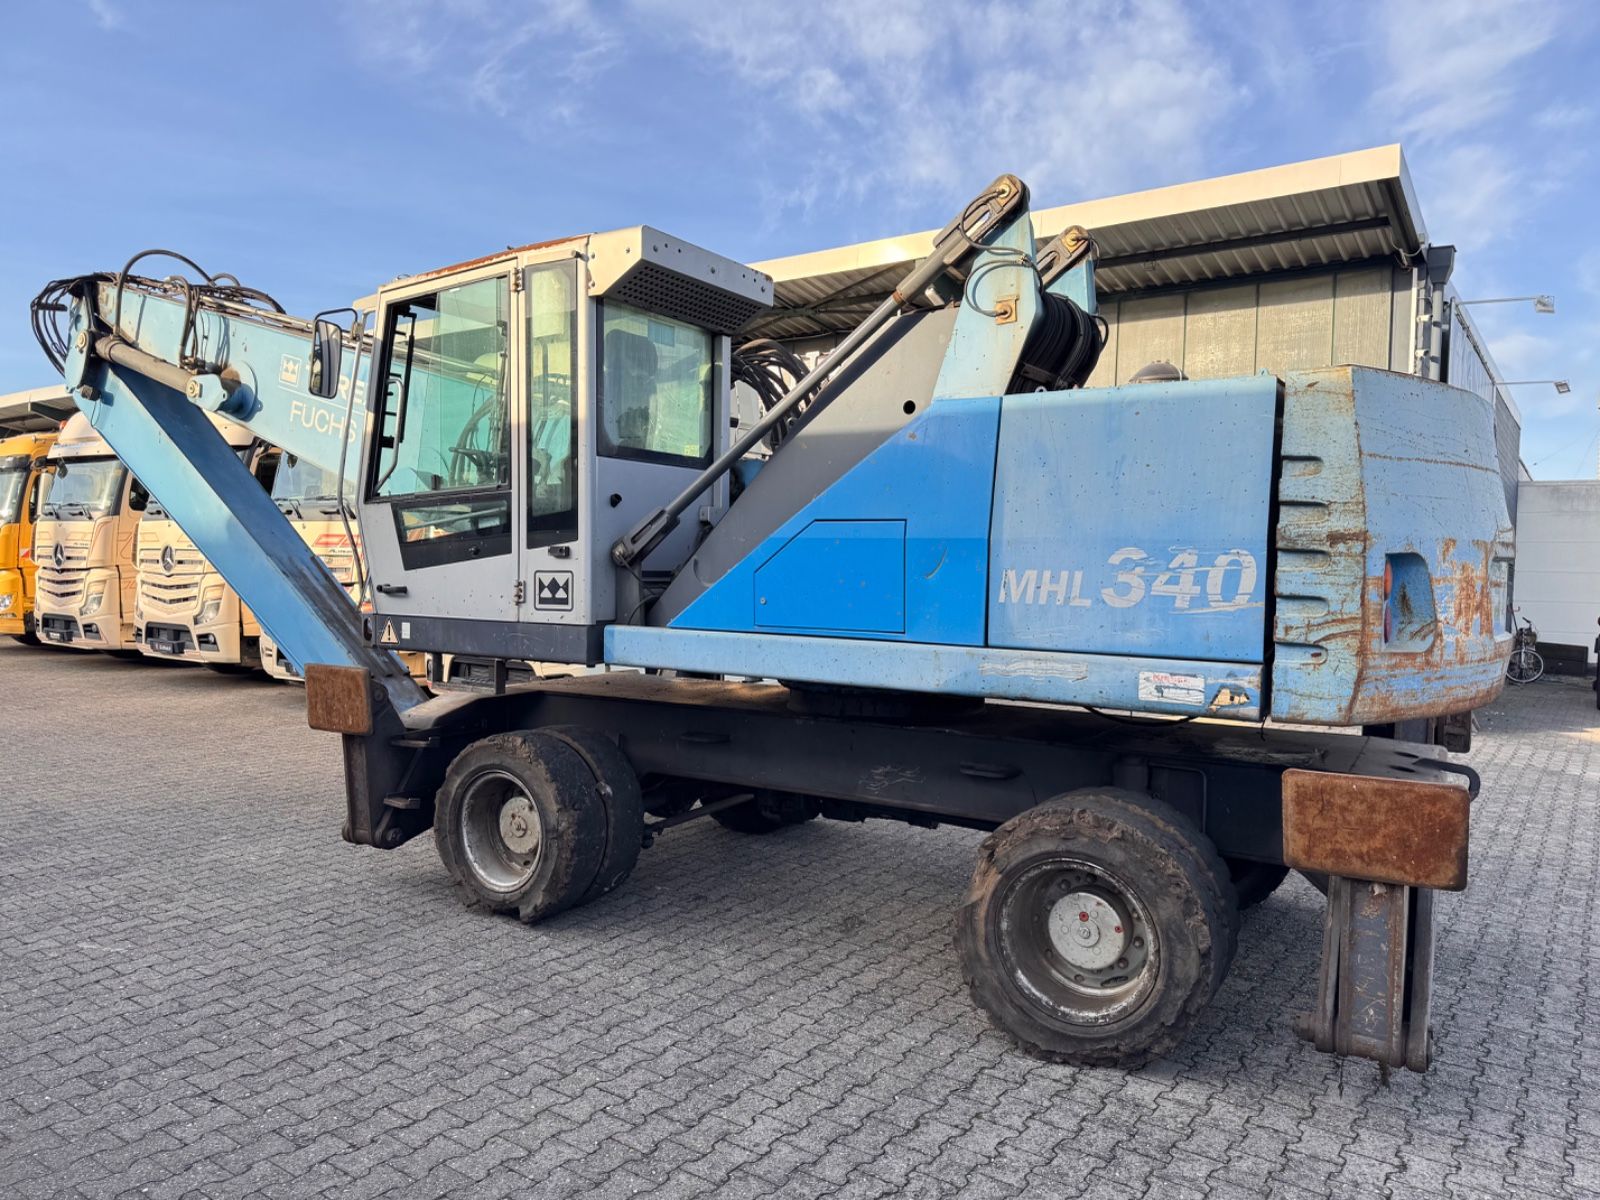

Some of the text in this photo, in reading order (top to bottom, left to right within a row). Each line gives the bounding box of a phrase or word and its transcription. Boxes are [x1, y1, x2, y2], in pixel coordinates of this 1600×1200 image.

[289, 400, 357, 443] FUCHS
[998, 546, 1257, 611] MHL 340
